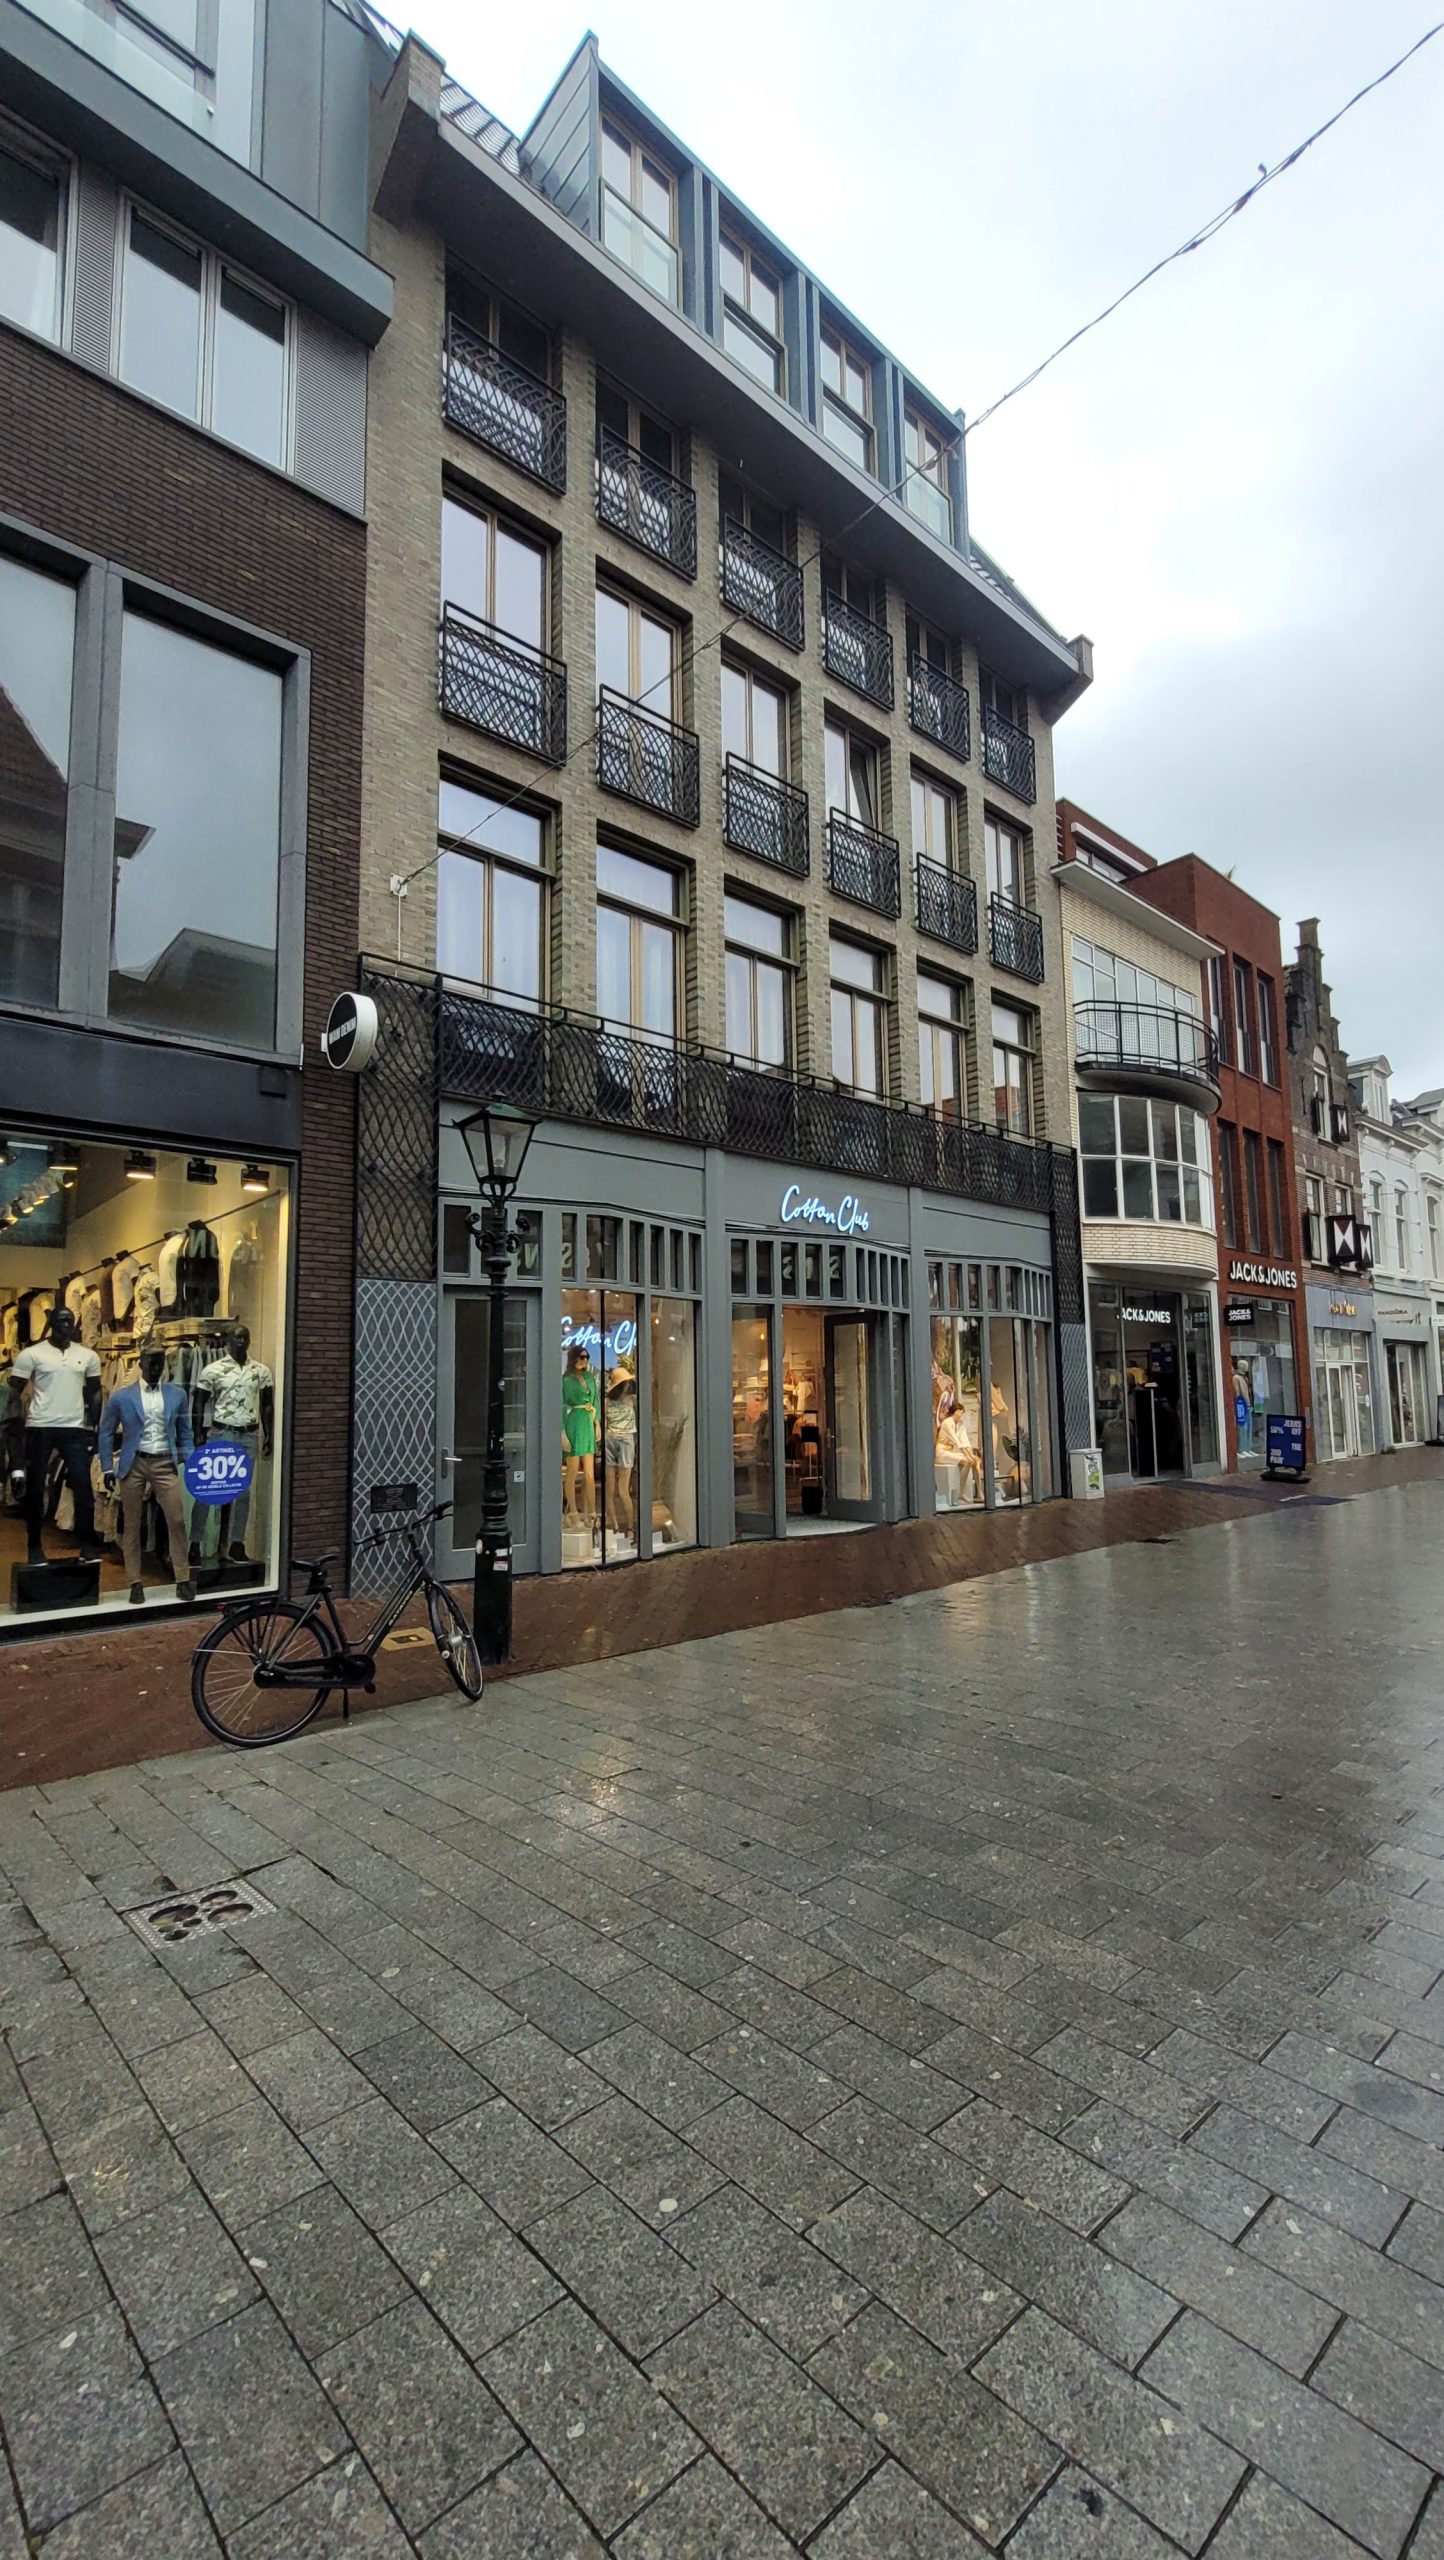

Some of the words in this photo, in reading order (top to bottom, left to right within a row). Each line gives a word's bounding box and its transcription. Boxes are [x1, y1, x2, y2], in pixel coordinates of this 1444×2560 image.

[781, 1184, 836, 1224] Cotton
[837, 1195, 869, 1235] Club
[1230, 1260, 1297, 1289] JACK&JONES
[187, 1454, 247, 1480] -30%
